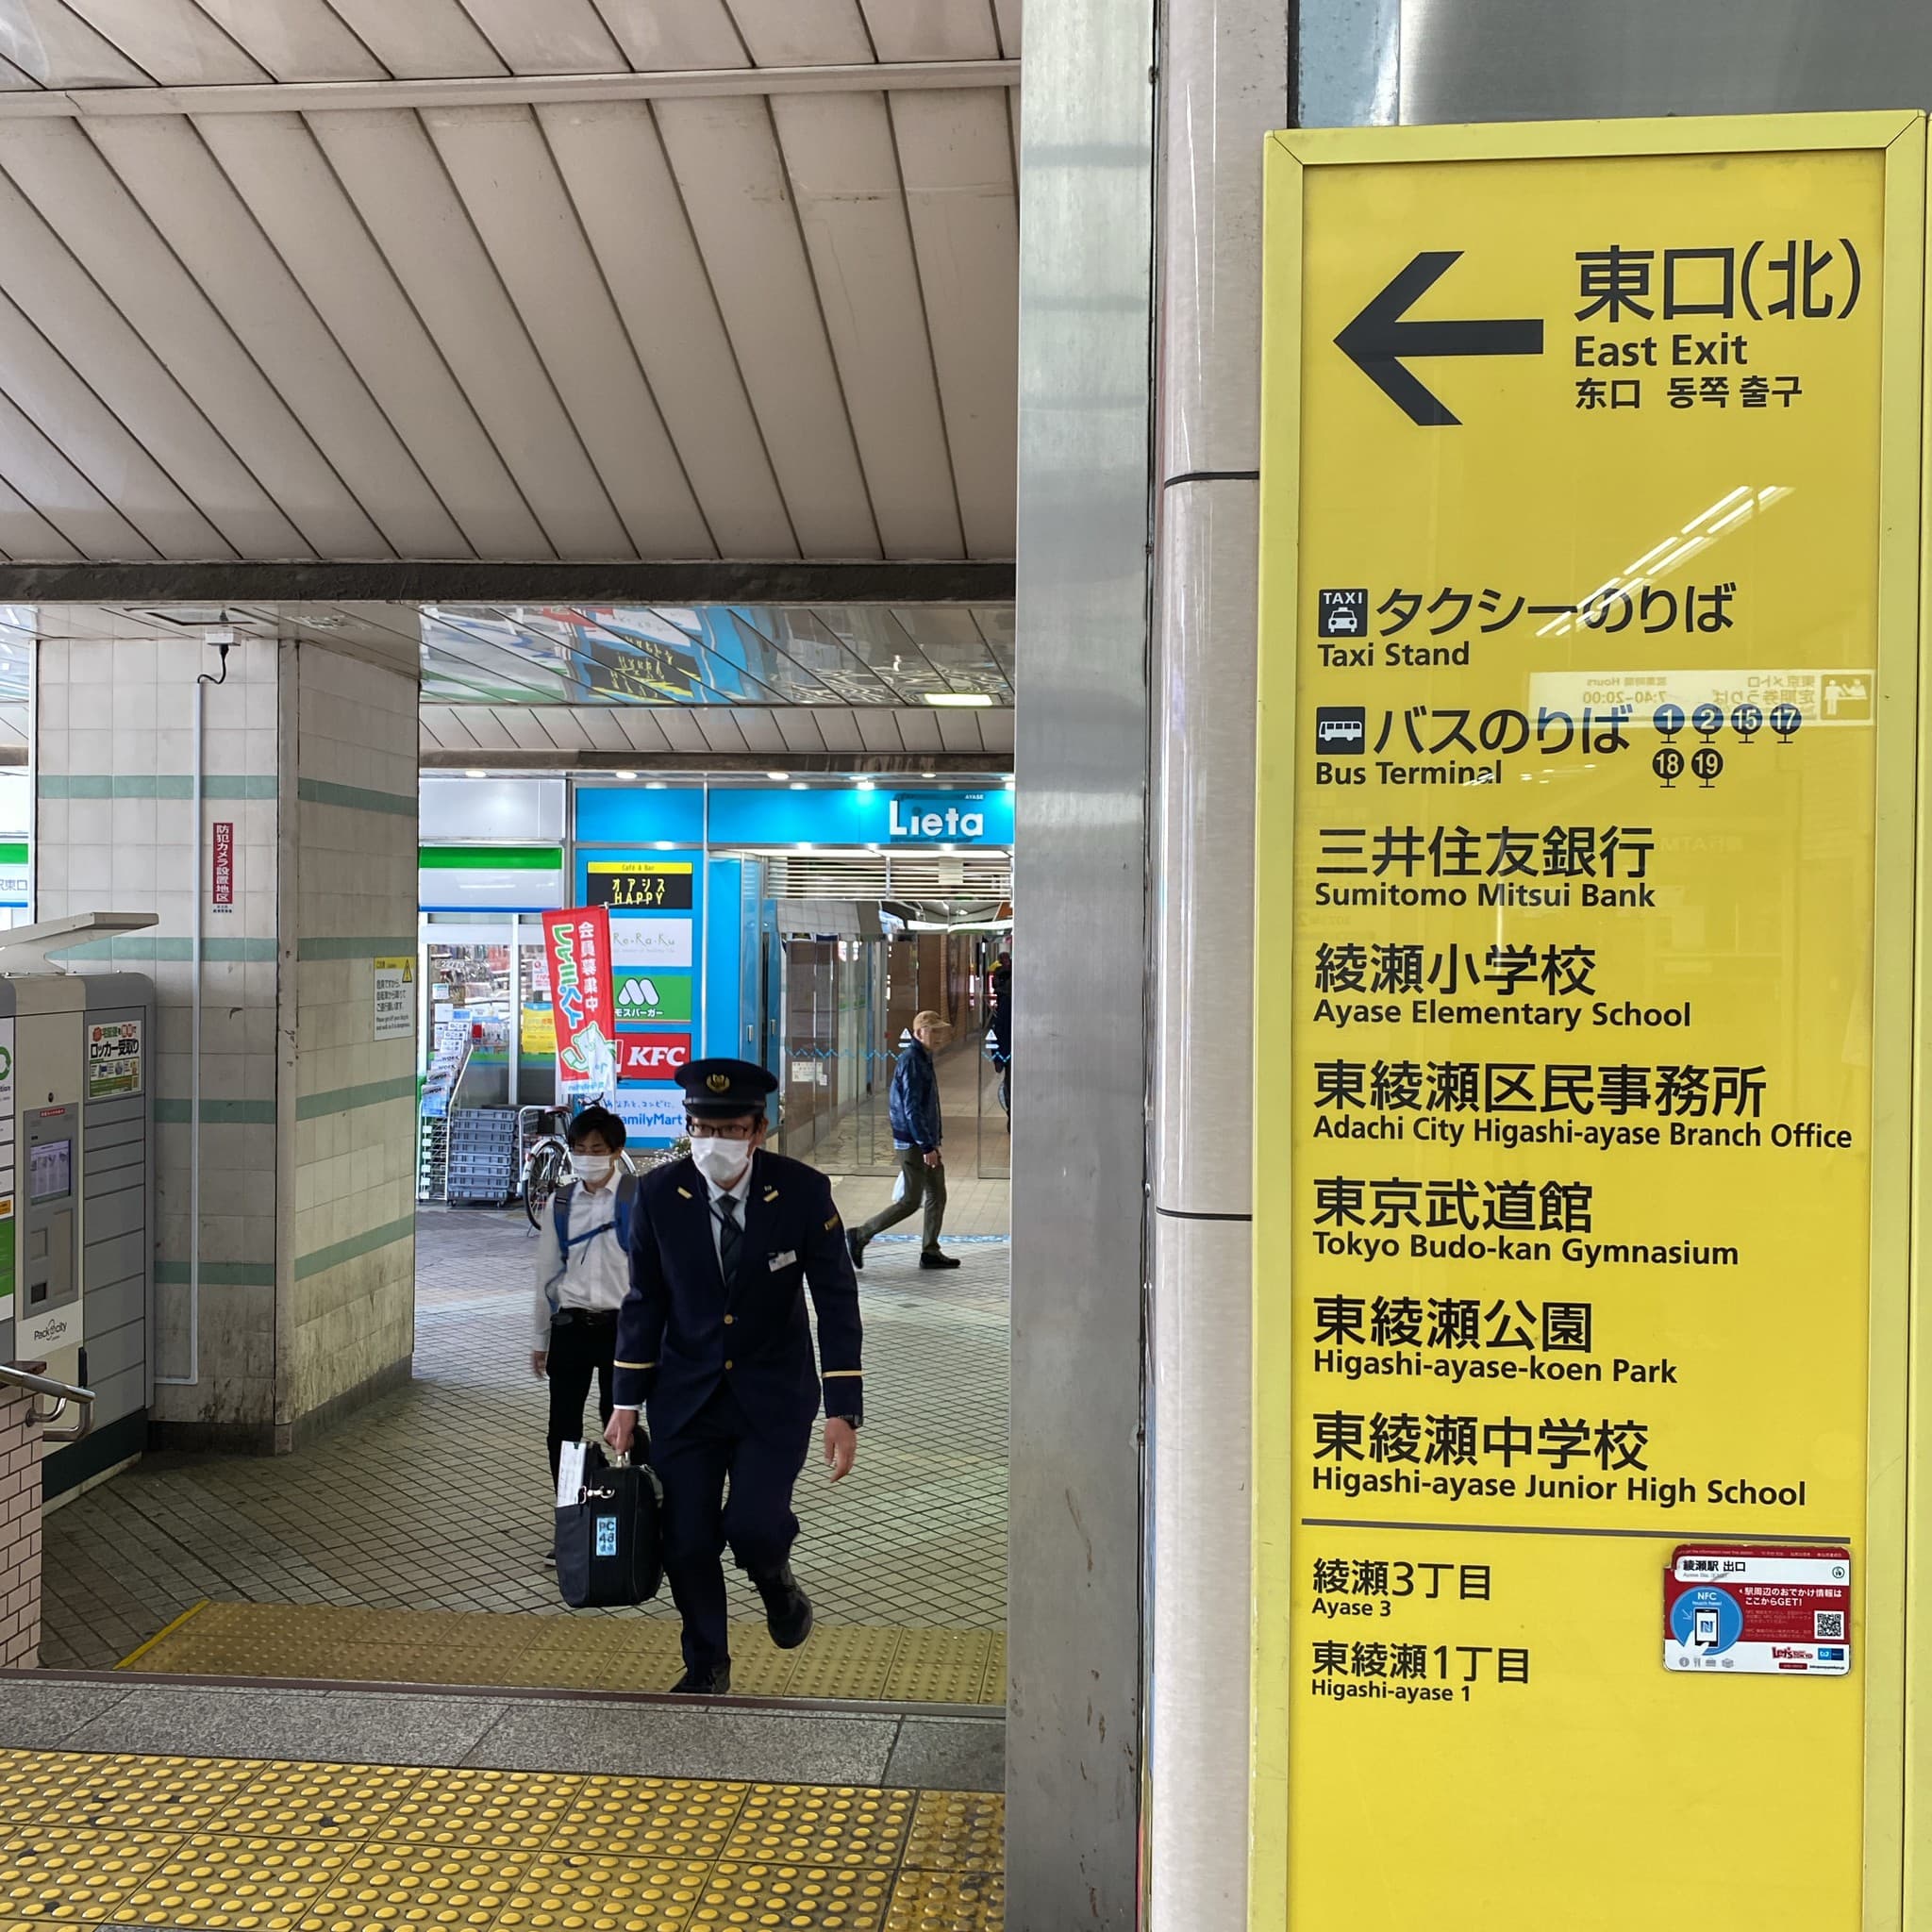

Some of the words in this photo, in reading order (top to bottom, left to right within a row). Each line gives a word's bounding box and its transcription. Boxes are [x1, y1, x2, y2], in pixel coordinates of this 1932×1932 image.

[1574, 238, 1861, 324] 東口(北)
[1575, 335, 1657, 367] East
[1672, 331, 1748, 366] Exit
[1575, 376, 1641, 410] 东口
[1666, 376, 1730, 409] 동쪽
[1739, 375, 1803, 408] 출구
[1323, 591, 1362, 605] TAXI
[1375, 585, 1737, 637] タクシーのりば
[1317, 641, 1374, 667] Taxi
[1385, 641, 1470, 667] Stand
[1373, 705, 1634, 755] バスのりば
[1738, 708, 1757, 729] 15
[1774, 708, 1796, 729] 17
[1316, 761, 1367, 785] Bus
[1374, 759, 1502, 785] Terminal
[1657, 754, 1680, 774] 18
[1694, 754, 1719, 774] 19
[889, 799, 984, 837] Lieta
[215, 824, 230, 903] 防犯カメラ設置地区
[1316, 824, 1655, 878] 三井住友銀行
[612, 877, 665, 892] オアシス
[614, 891, 663, 906] HAPPY
[1315, 881, 1467, 907] Sumitomo
[1478, 882, 1570, 908] Mitsui
[1581, 882, 1656, 908] Bank
[1314, 941, 1596, 996] 綾瀬小学校
[614, 1008, 663, 1017] モスバーガー
[1312, 999, 1402, 1029] Ayase
[1412, 998, 1582, 1032] Elementary
[1591, 1001, 1690, 1027] School
[627, 1045, 687, 1067] KFC
[1313, 1058, 1767, 1119] 東綾瀬区民事務所
[621, 1113, 683, 1127] amilyMart
[1312, 1113, 1404, 1140] Adachi
[1412, 1116, 1465, 1148] City
[1474, 1117, 1660, 1151] Higashi-ayase
[1670, 1123, 1761, 1147] Branch
[1771, 1124, 1852, 1149] Office
[1312, 1174, 1592, 1234] 東京武道館
[1312, 1230, 1400, 1262] Tokyo
[1410, 1233, 1551, 1261] Budo-kan
[1561, 1238, 1739, 1269] Gymnasium
[1313, 1293, 1592, 1354] 東綾瀬公園
[1314, 1349, 1602, 1384] Higashi-ayase-koen
[1613, 1358, 1677, 1384] Park
[1312, 1409, 1649, 1472] 東綾瀬中学校
[1313, 1467, 1516, 1502] Higashi-ayase
[1524, 1474, 1618, 1500] Junior
[1627, 1476, 1696, 1508] High
[1707, 1478, 1806, 1506] School
[1312, 1557, 1491, 1602] 綾瀬3丁目
[1682, 1559, 1719, 1573] 綾瀬駅
[1723, 1560, 1746, 1573] 出口
[1311, 1597, 1374, 1619] Ayase
[1379, 1600, 1391, 1617] 3
[1696, 1591, 1717, 1601] NFC
[1745, 1597, 1803, 1607] ここからGET!
[1311, 1640, 1528, 1684] 東綾瀬1丁目
[1311, 1678, 1454, 1705] Higashi-ayase
[1461, 1685, 1470, 1702] 1
